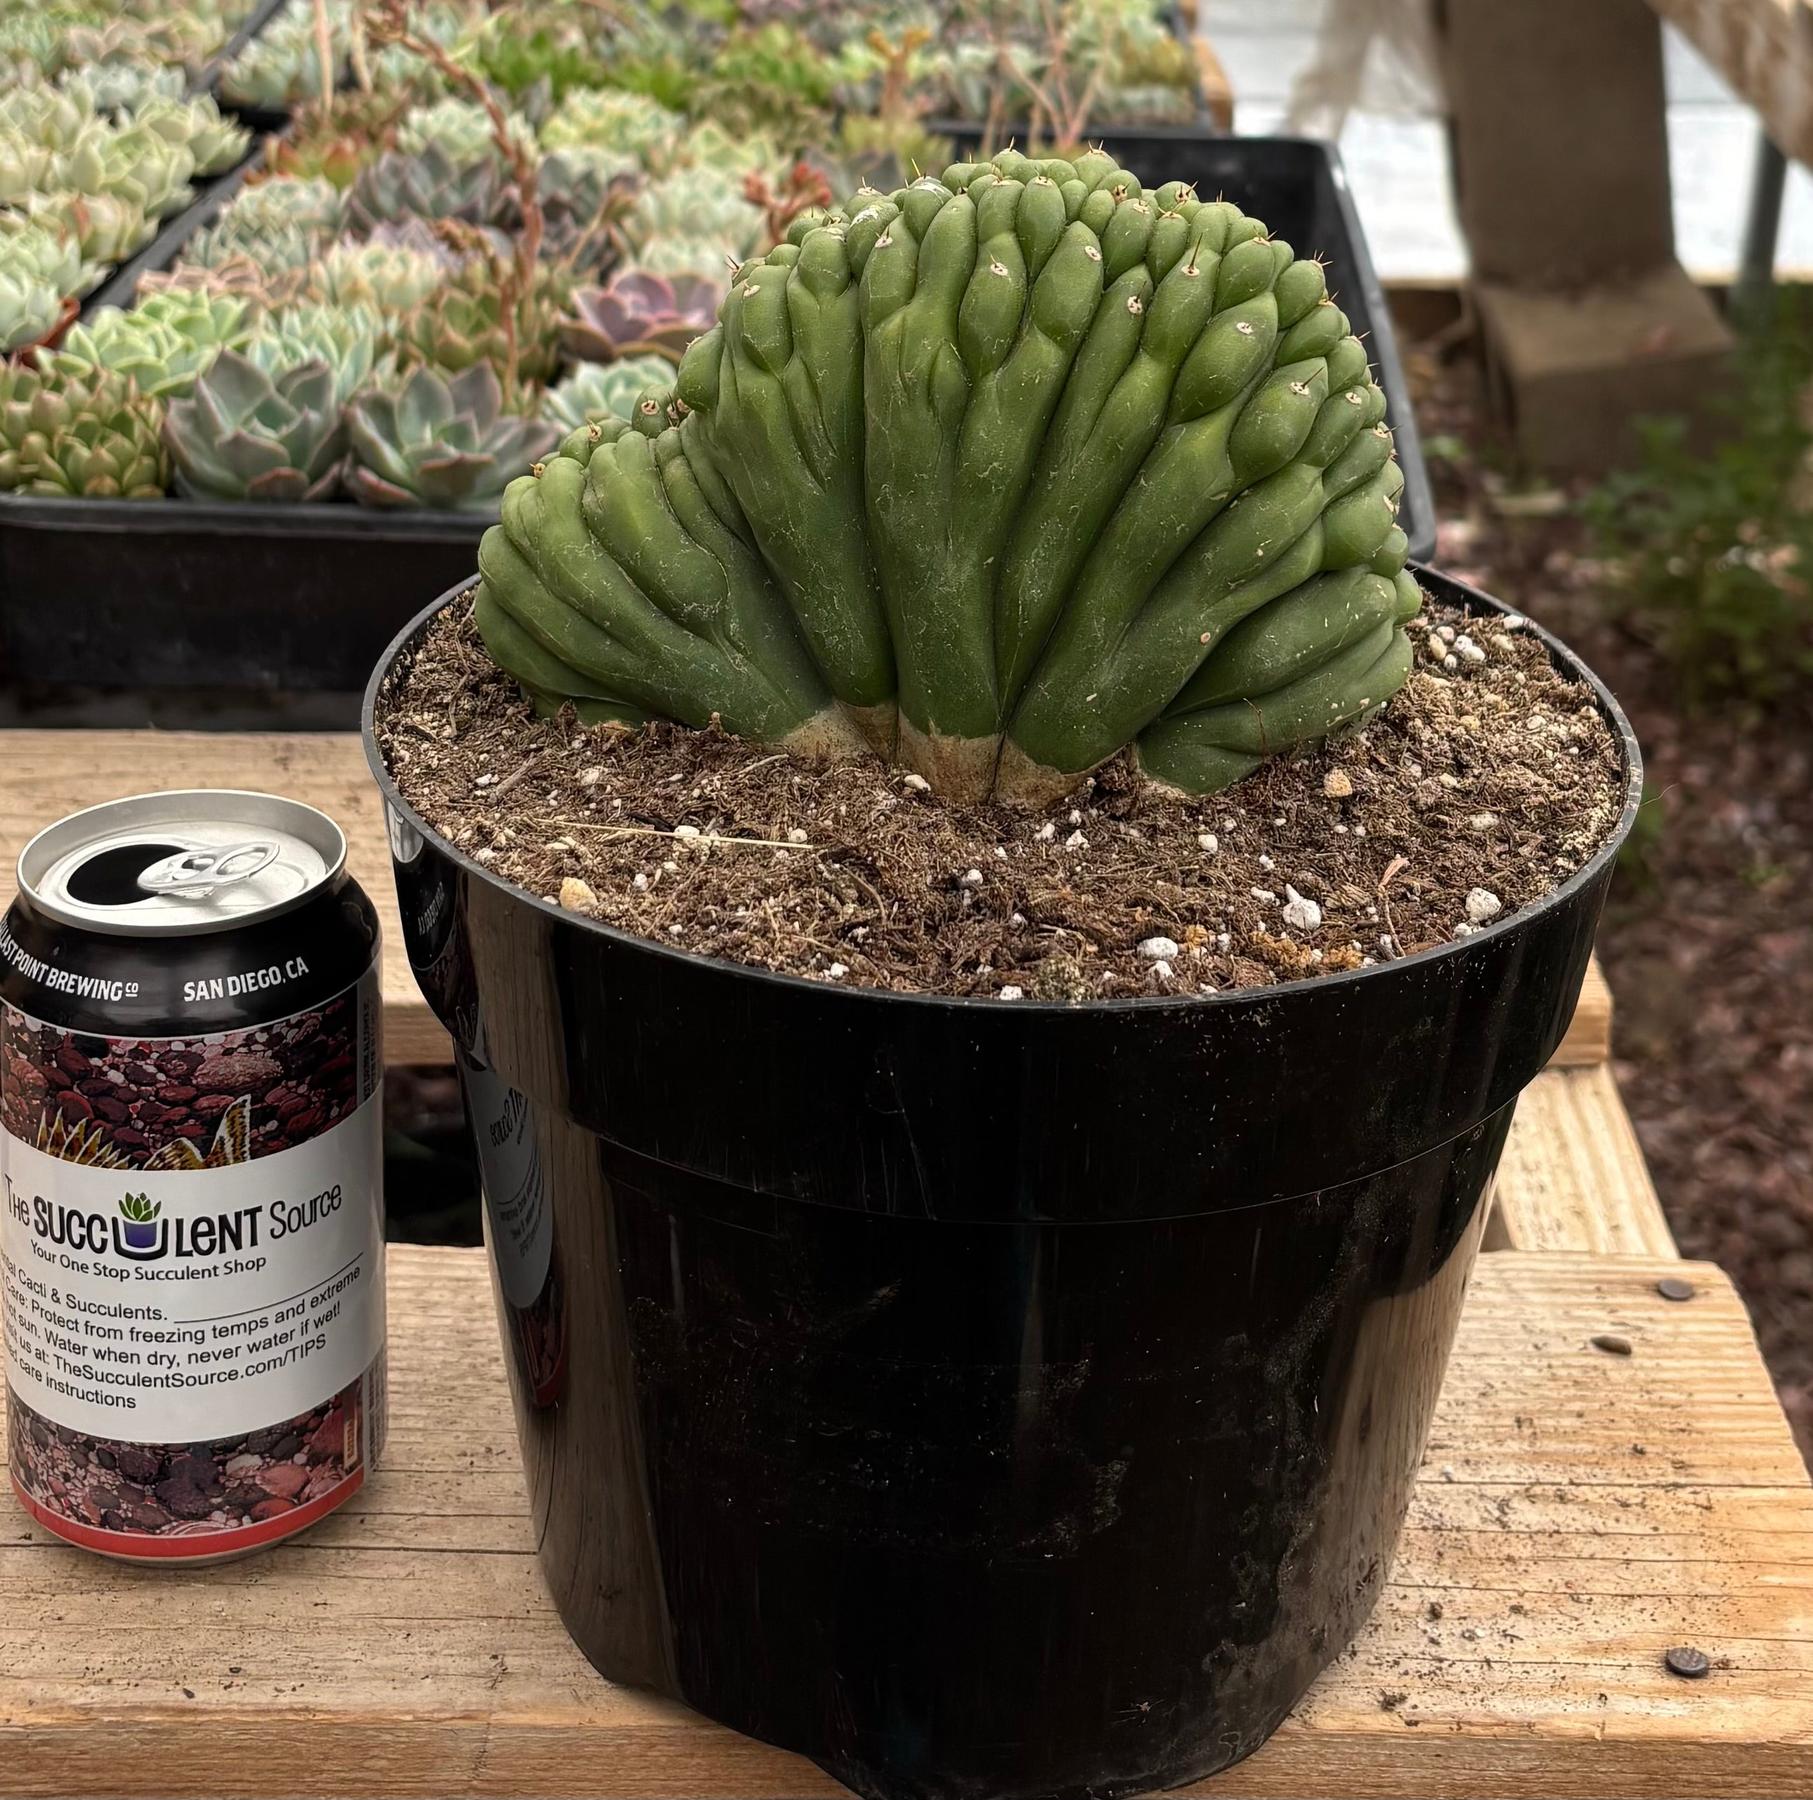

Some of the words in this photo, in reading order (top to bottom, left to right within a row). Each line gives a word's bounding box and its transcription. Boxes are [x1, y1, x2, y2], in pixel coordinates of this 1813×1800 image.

[12, 948, 50, 983] POINT
[45, 967, 123, 1002] BREWING
[183, 978, 225, 1002] SAN
[226, 966, 286, 997] DIEGO,
[285, 956, 309, 979] CA
[269, 1184, 342, 1240] Source
[30, 1239, 57, 1264] Your
[59, 1254, 90, 1275] One
[93, 1262, 131, 1283] Stop
[134, 1264, 220, 1281] Succulent
[223, 1256, 267, 1276] Shop
[18, 1268, 48, 1299] Cacti
[50, 1288, 61, 1305] &
[65, 1293, 168, 1321] Succulents.
[31, 1299, 80, 1334] Protect
[84, 1320, 123, 1341] from
[129, 1326, 206, 1346] freezing
[212, 1316, 270, 1339] temps
[274, 1299, 306, 1325] and
[310, 1266, 361, 1309] extreme
[18, 1313, 41, 1339] sun.
[44, 1326, 89, 1357] Water
[92, 1346, 141, 1365] when
[146, 1350, 181, 1370] dry,
[187, 1345, 242, 1365] never
[246, 1328, 297, 1355] water
[300, 1318, 310, 1337] if
[313, 1300, 341, 1330] wet!
[19, 1335, 32, 1354] us
[34, 1347, 50, 1366] at:
[52, 1333, 327, 1389] TheSucculentSource.com/TIPS
[19, 1358, 43, 1383] care
[45, 1371, 137, 1409] instructions
